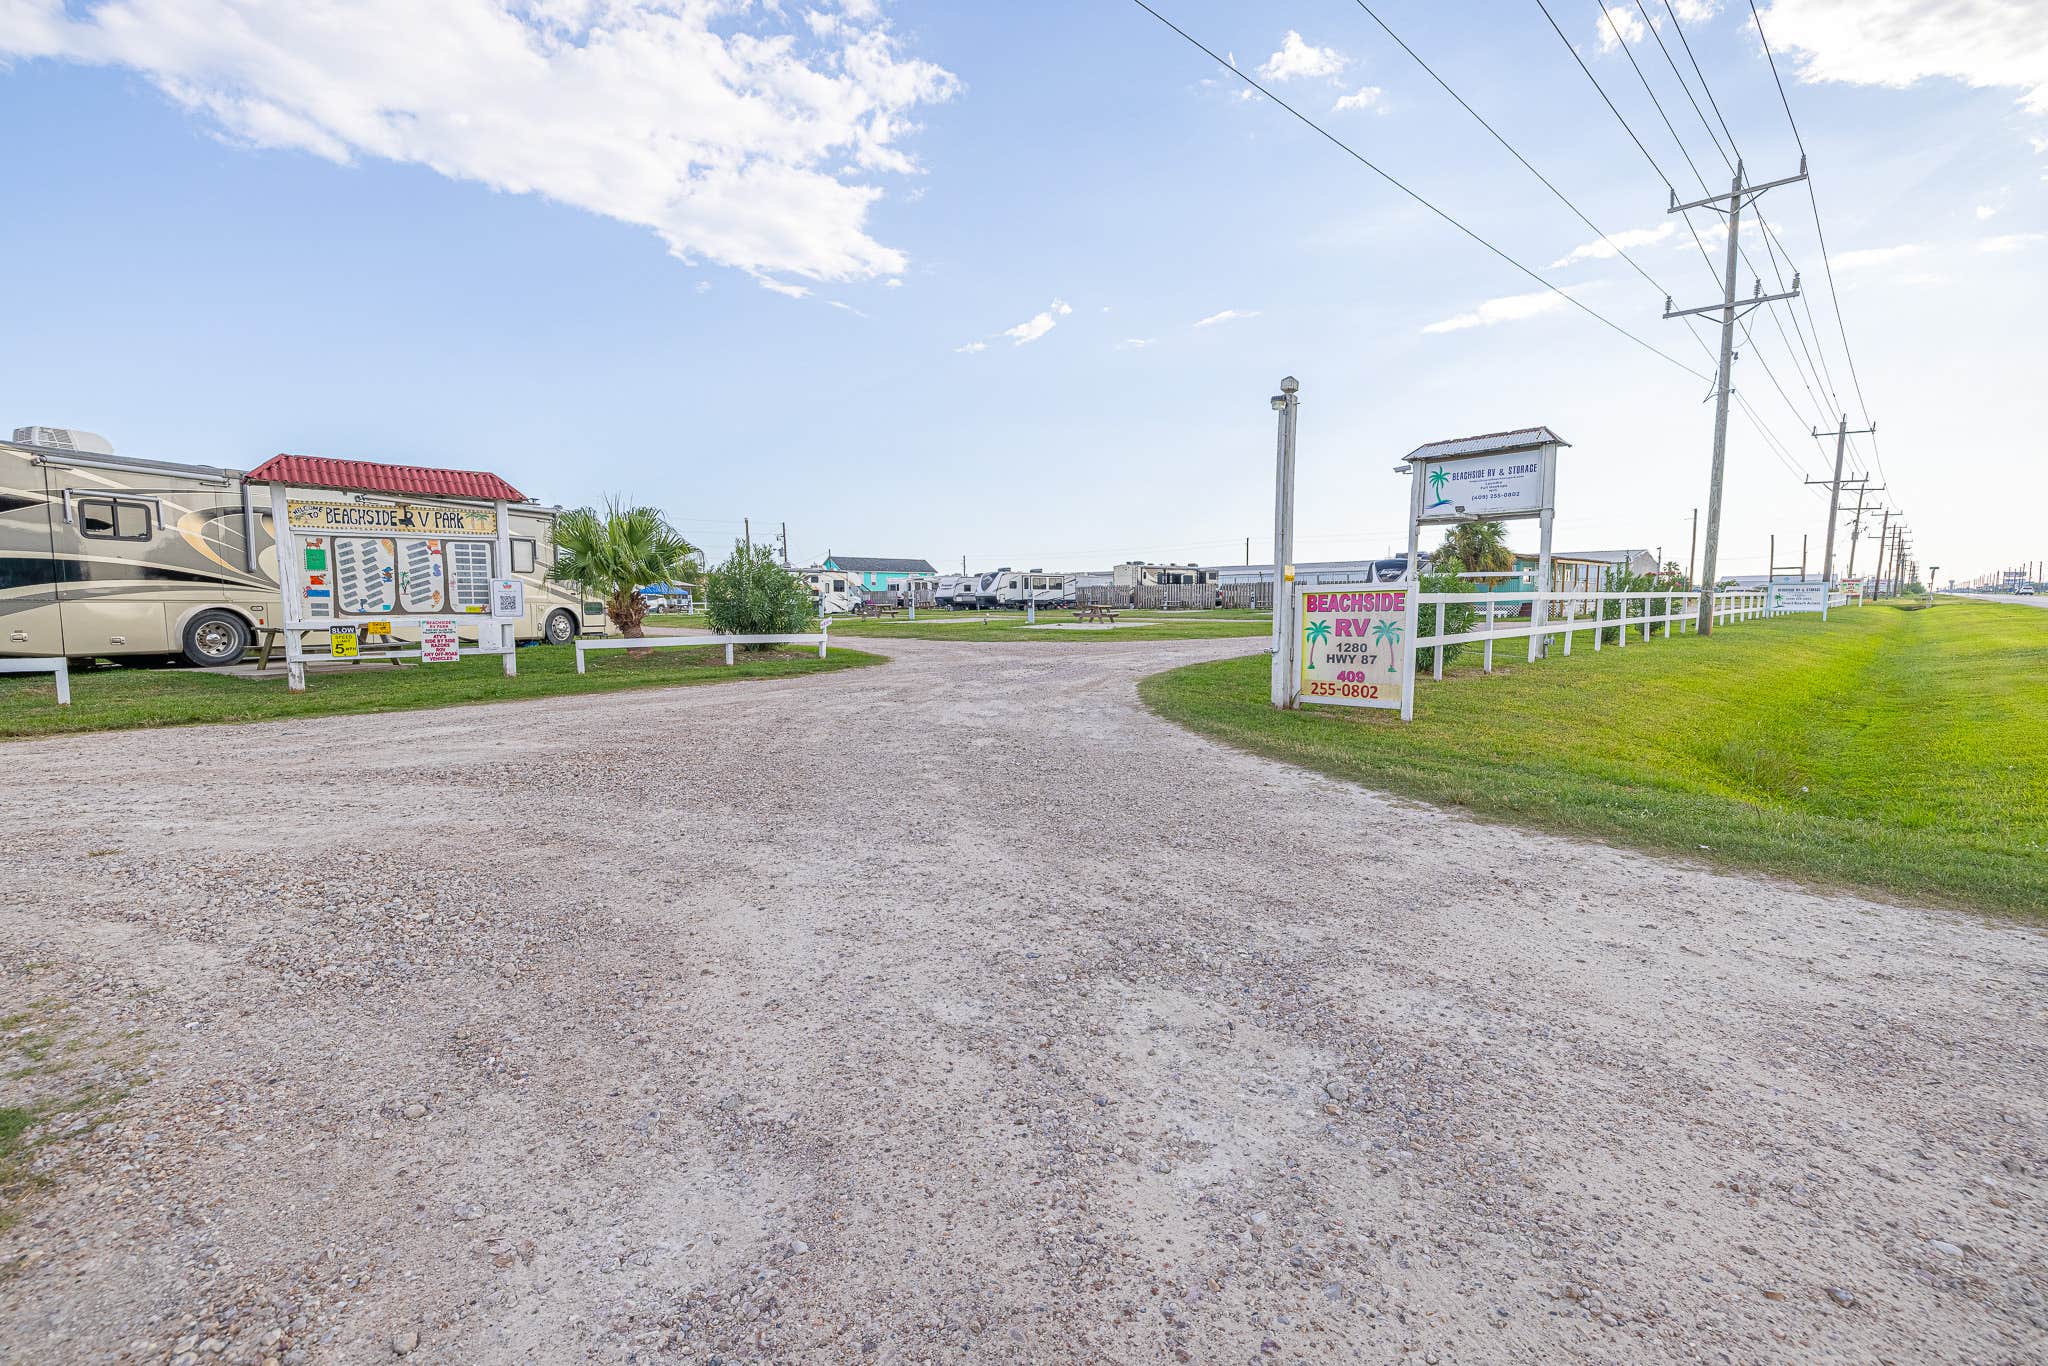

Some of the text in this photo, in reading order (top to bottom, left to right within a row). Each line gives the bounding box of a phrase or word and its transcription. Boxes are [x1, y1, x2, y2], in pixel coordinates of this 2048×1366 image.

[1452, 469, 1484, 480] BEACHSIDE
[1487, 468, 1496, 477] RV
[1498, 468, 1505, 476] &
[1508, 463, 1538, 475] STORAGE
[1490, 491, 1520, 499] 255-0802
[293, 505, 323, 515] WELCOME
[325, 507, 398, 526] BEACHSIDE
[434, 511, 464, 529] PARK
[1306, 593, 1405, 612] BEACHSIDE
[1335, 618, 1371, 637] RV
[335, 643, 345, 654] 5
[1336, 642, 1368, 653] 1280
[1326, 654, 1377, 665] HWY 87
[1336, 670, 1366, 683] 409
[1311, 682, 1379, 699] 255-0802
